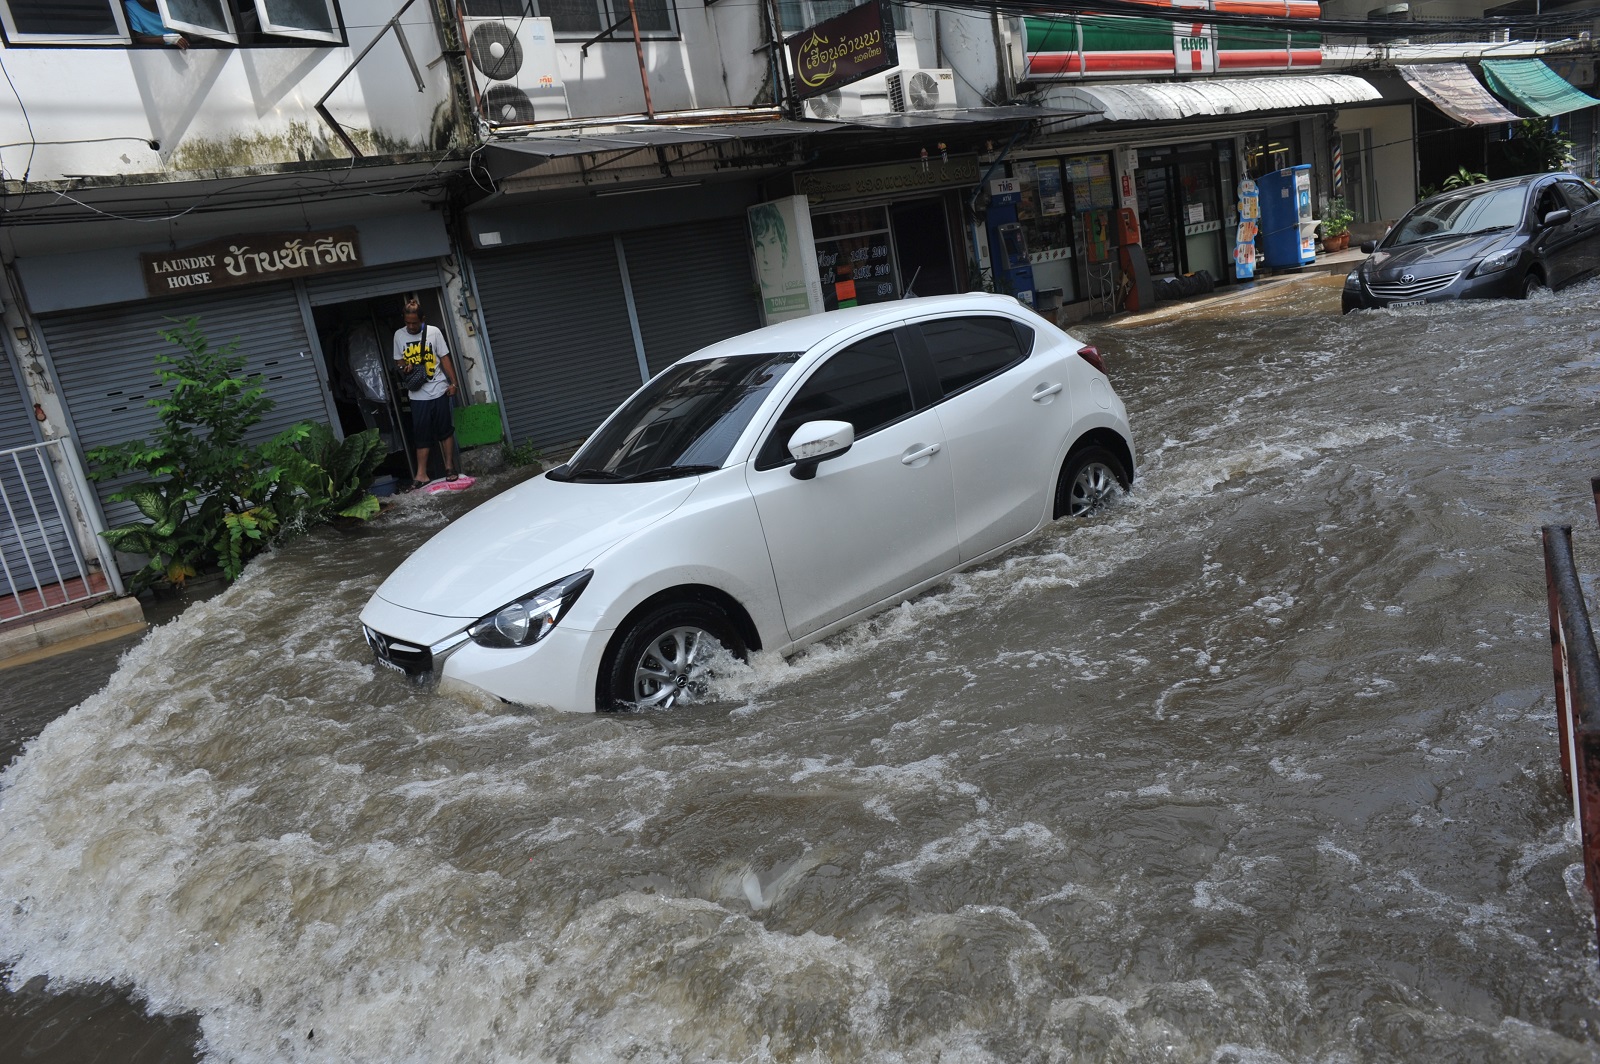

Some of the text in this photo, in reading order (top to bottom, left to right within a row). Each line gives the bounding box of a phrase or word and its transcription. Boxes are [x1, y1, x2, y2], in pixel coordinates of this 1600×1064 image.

[806, 29, 880, 70] เฮือนล้านนา
[940, 167, 951, 183] &
[998, 180, 1013, 192] TMB
[223, 236, 358, 277] บ้านซักรีด
[872, 245, 888, 259] 200
[152, 254, 217, 274] LAUNDRY
[875, 263, 891, 277] 200
[167, 272, 213, 289] HOUSE
